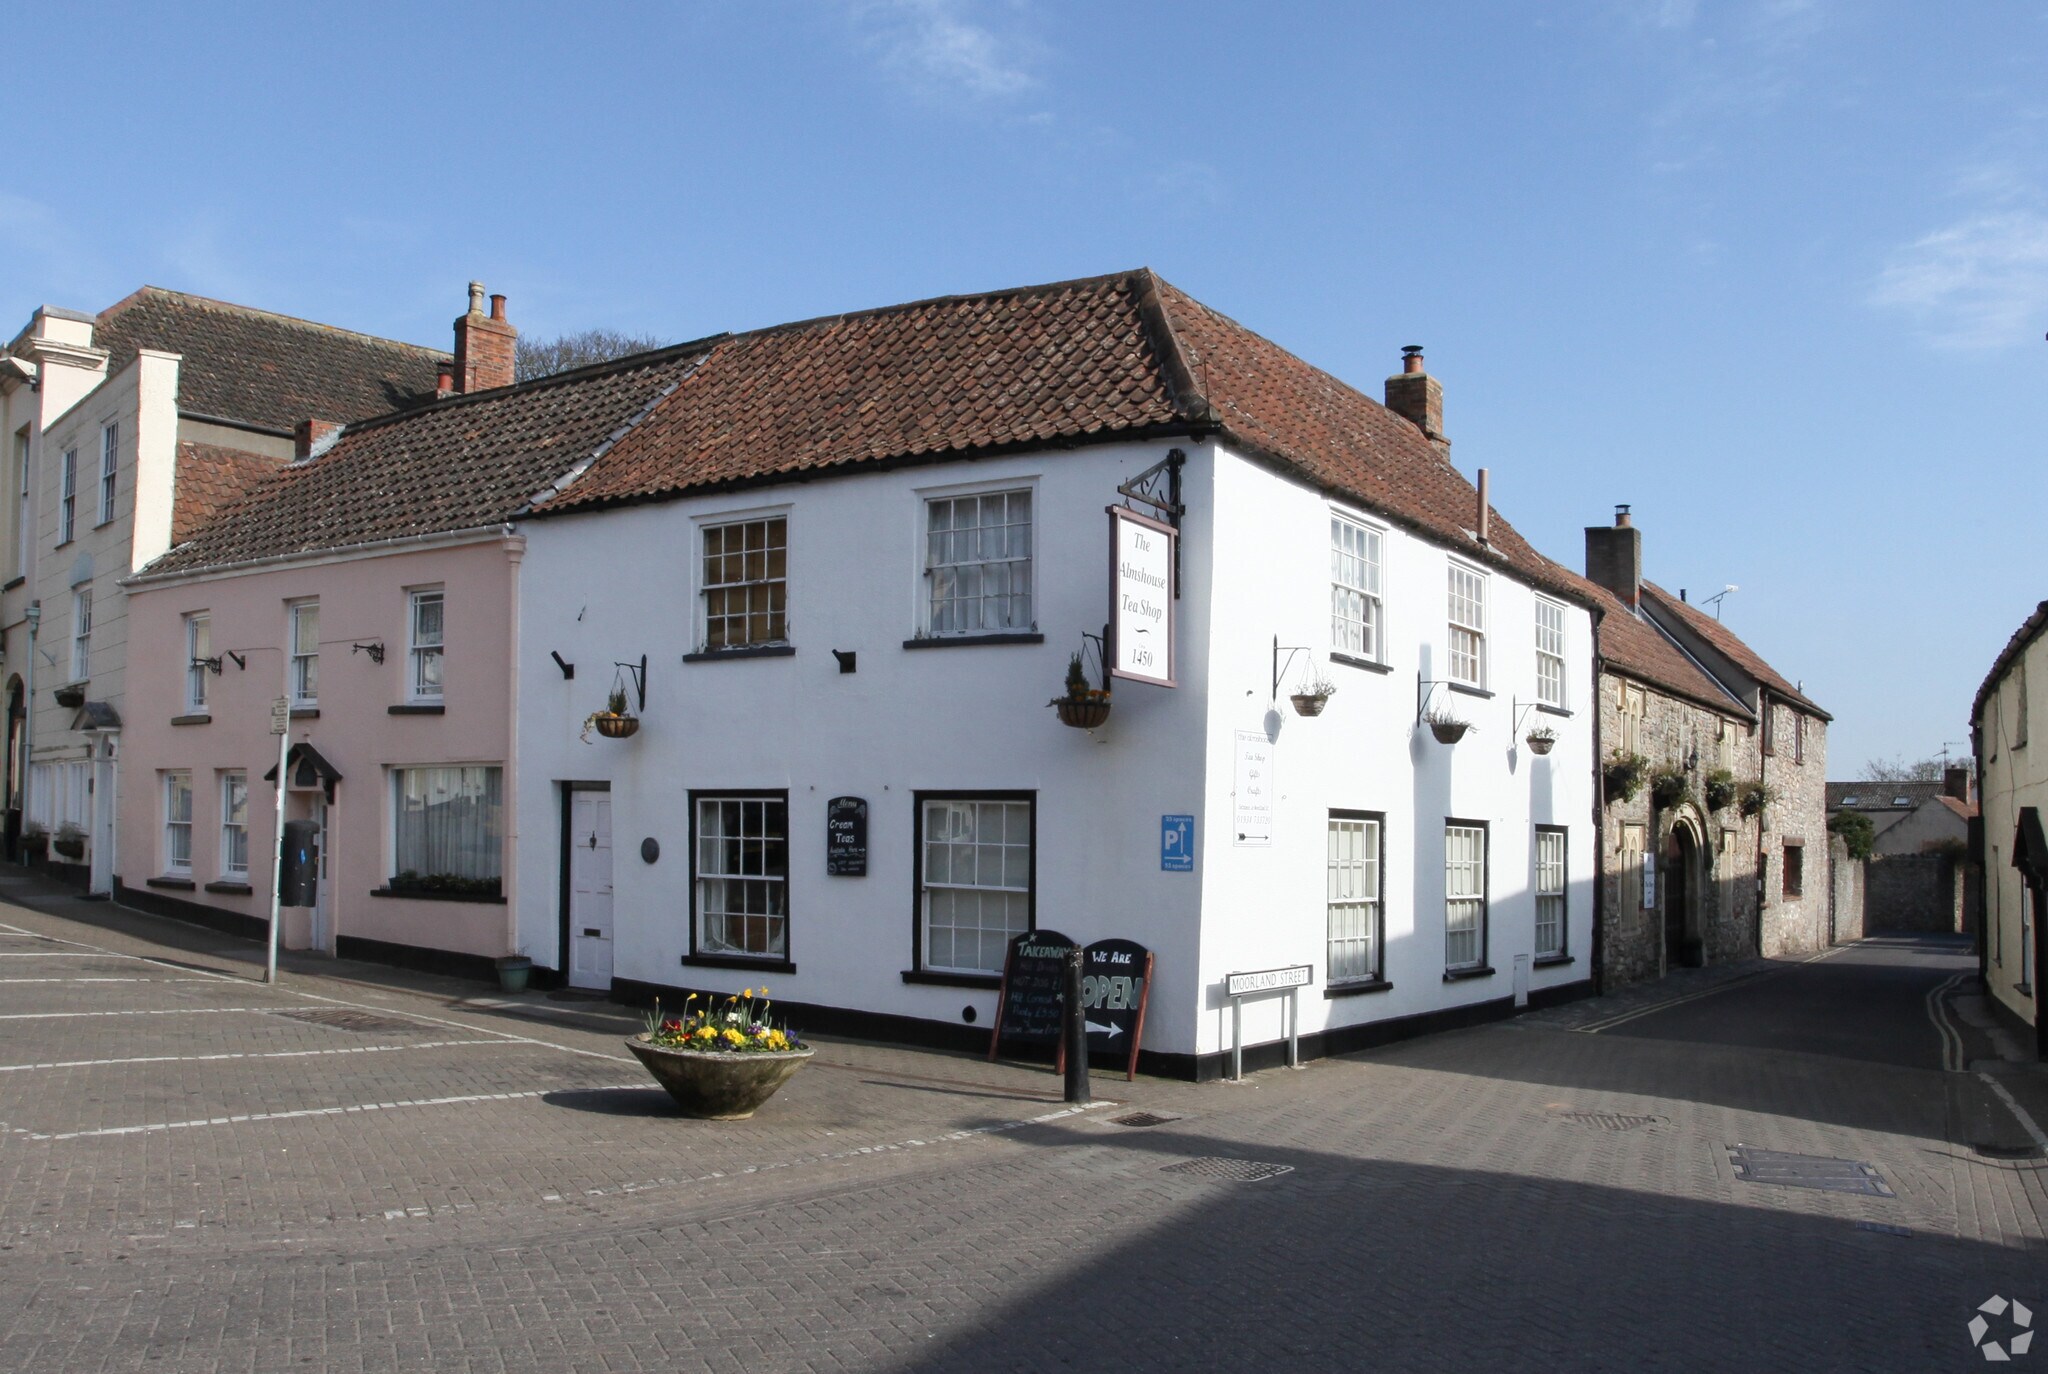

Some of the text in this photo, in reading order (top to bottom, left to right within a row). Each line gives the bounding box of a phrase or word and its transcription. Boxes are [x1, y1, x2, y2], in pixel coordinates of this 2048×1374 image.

[1134, 532, 1151, 552] The
[1120, 561, 1165, 589] Almshouse
[1122, 593, 1162, 623] Tea Shop
[1132, 648, 1153, 667] 1450
[838, 799, 857, 808] Menu
[829, 819, 854, 830] Cream
[835, 833, 855, 844] Teas
[1165, 830, 1179, 850] P
[1092, 951, 1132, 964] WE ARE
[1232, 970, 1306, 991] MOORLAND STREET
[1083, 975, 1144, 1010] OPEN
